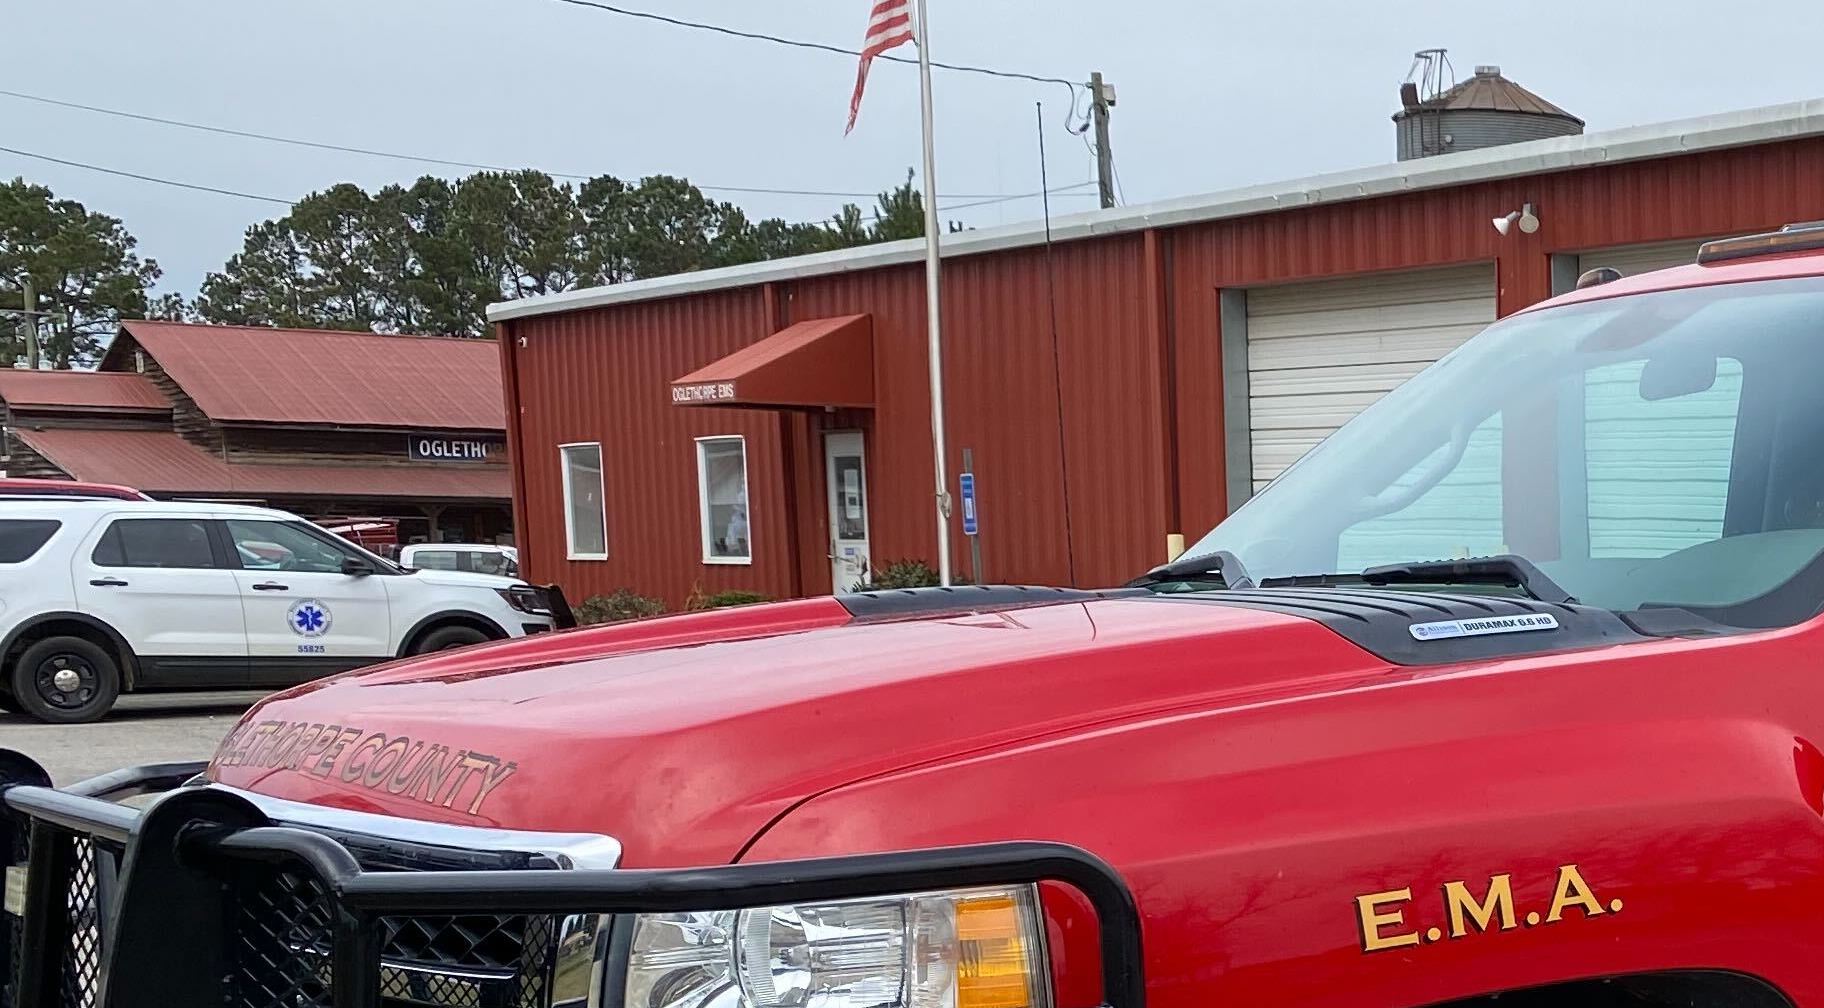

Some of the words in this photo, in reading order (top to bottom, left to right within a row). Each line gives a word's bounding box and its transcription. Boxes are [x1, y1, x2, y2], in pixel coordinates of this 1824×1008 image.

[1463, 619, 1517, 631] DURAMAX
[1517, 617, 1536, 627] 6.6
[1537, 616, 1552, 625] HD
[217, 720, 363, 780] LETHORPE
[341, 733, 518, 815] COUNTY
[1354, 864, 1623, 952] E.M.A.
